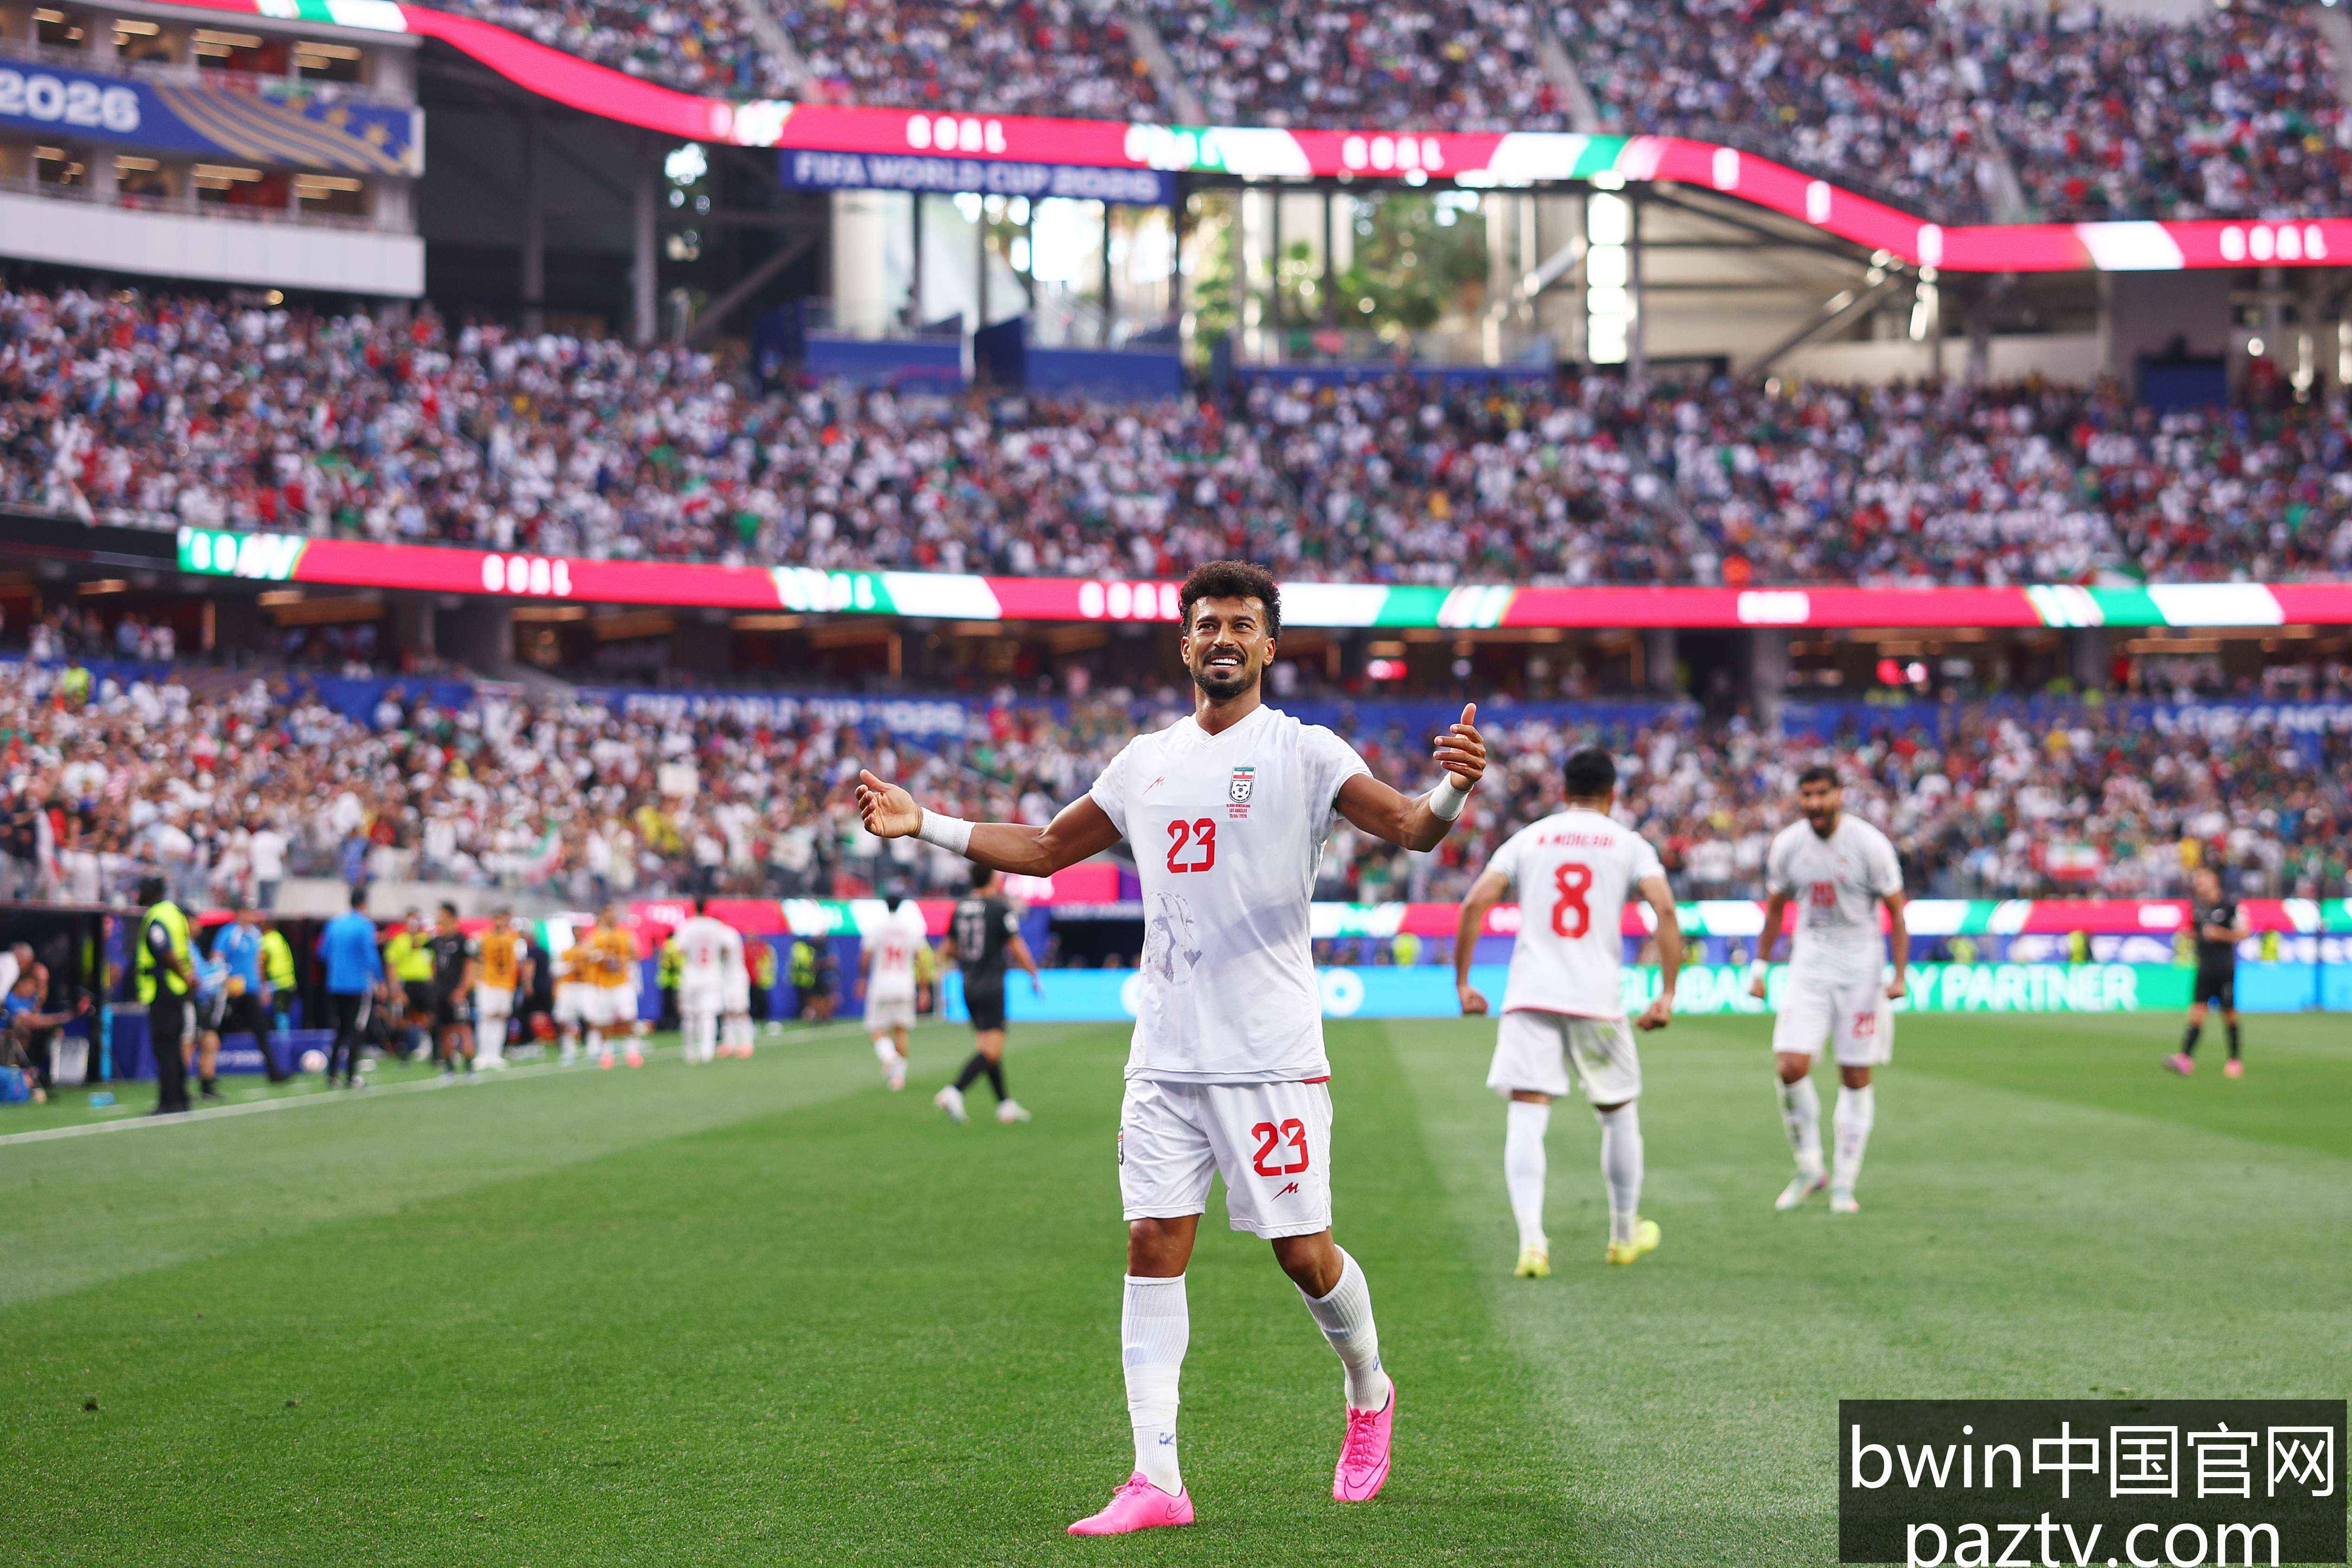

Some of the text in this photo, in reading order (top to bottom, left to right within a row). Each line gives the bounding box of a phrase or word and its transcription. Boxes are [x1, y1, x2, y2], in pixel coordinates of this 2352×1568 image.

[0, 69, 141, 133] 2026
[1167, 818, 1216, 873] 23
[1551, 862, 1593, 940] 8
[1941, 963, 2139, 1012] PARTNER
[1251, 1118, 1309, 1177] 23
